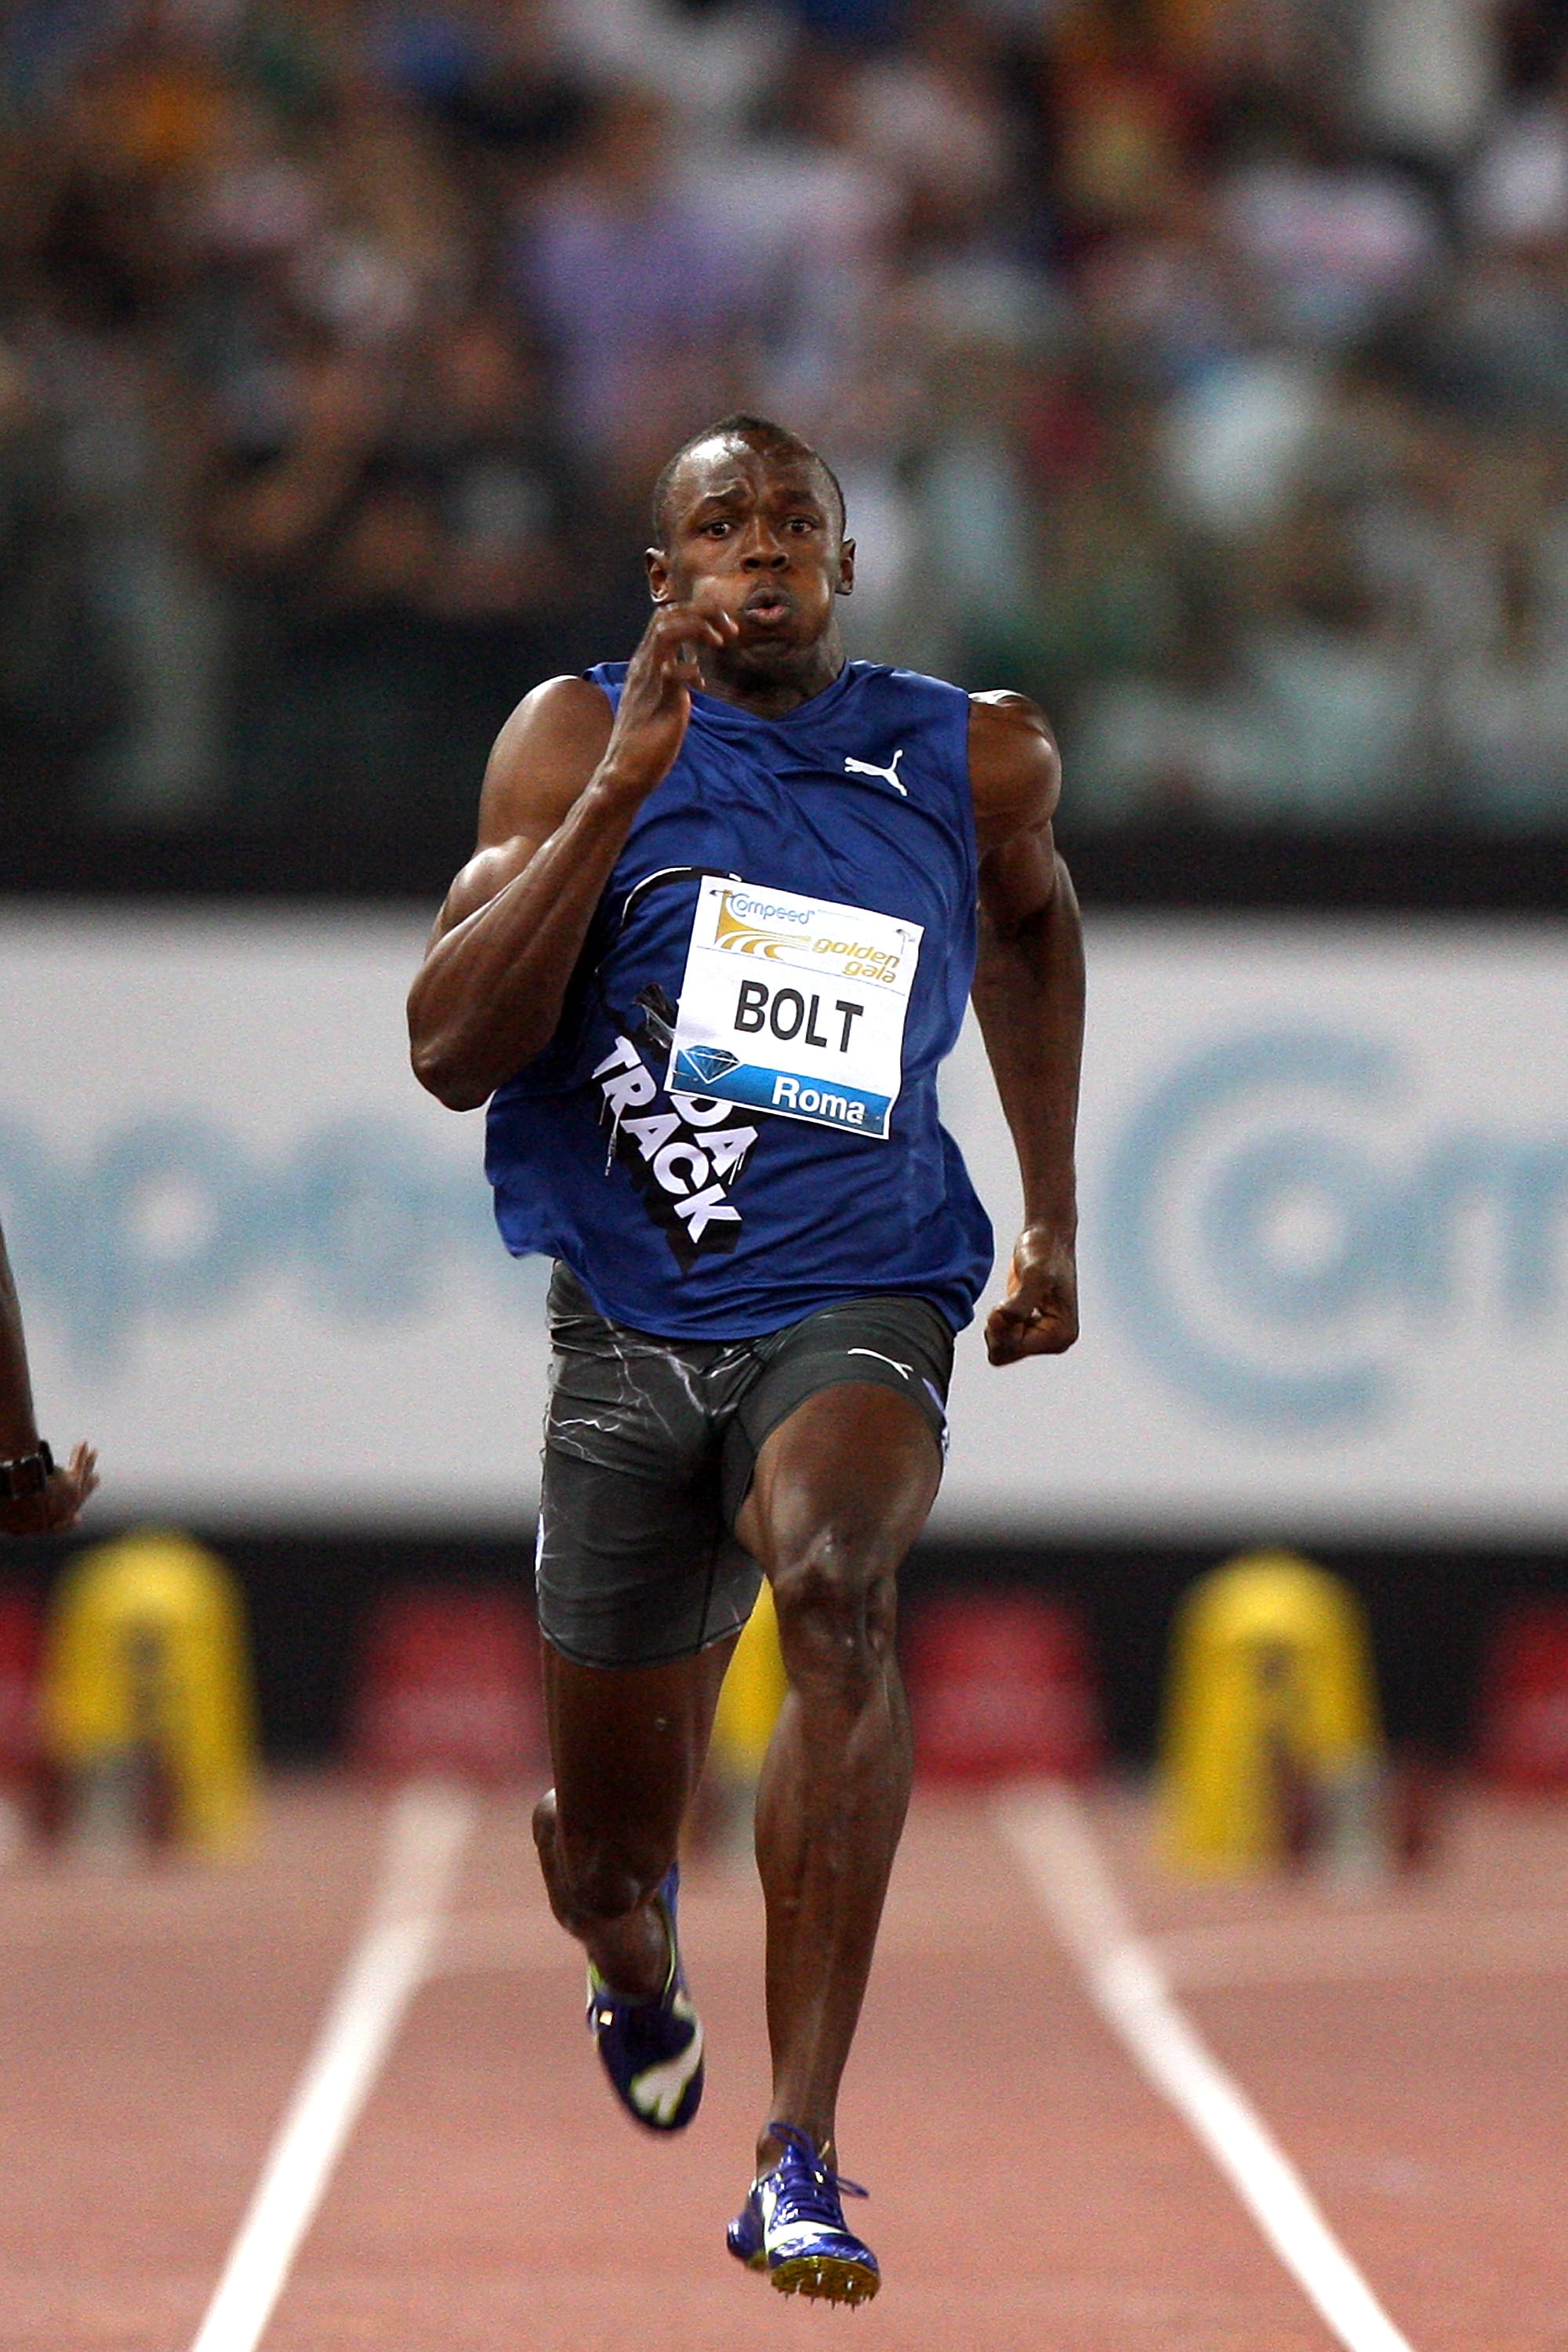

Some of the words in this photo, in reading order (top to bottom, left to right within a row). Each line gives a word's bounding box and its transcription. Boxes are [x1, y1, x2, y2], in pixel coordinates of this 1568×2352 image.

[730, 892, 811, 924] Compeed
[813, 938, 900, 968] golden
[842, 959, 897, 984] gala
[735, 979, 865, 1054] BOLT
[771, 1075, 866, 1125] Roma
[591, 1035, 742, 1243] TRACK
